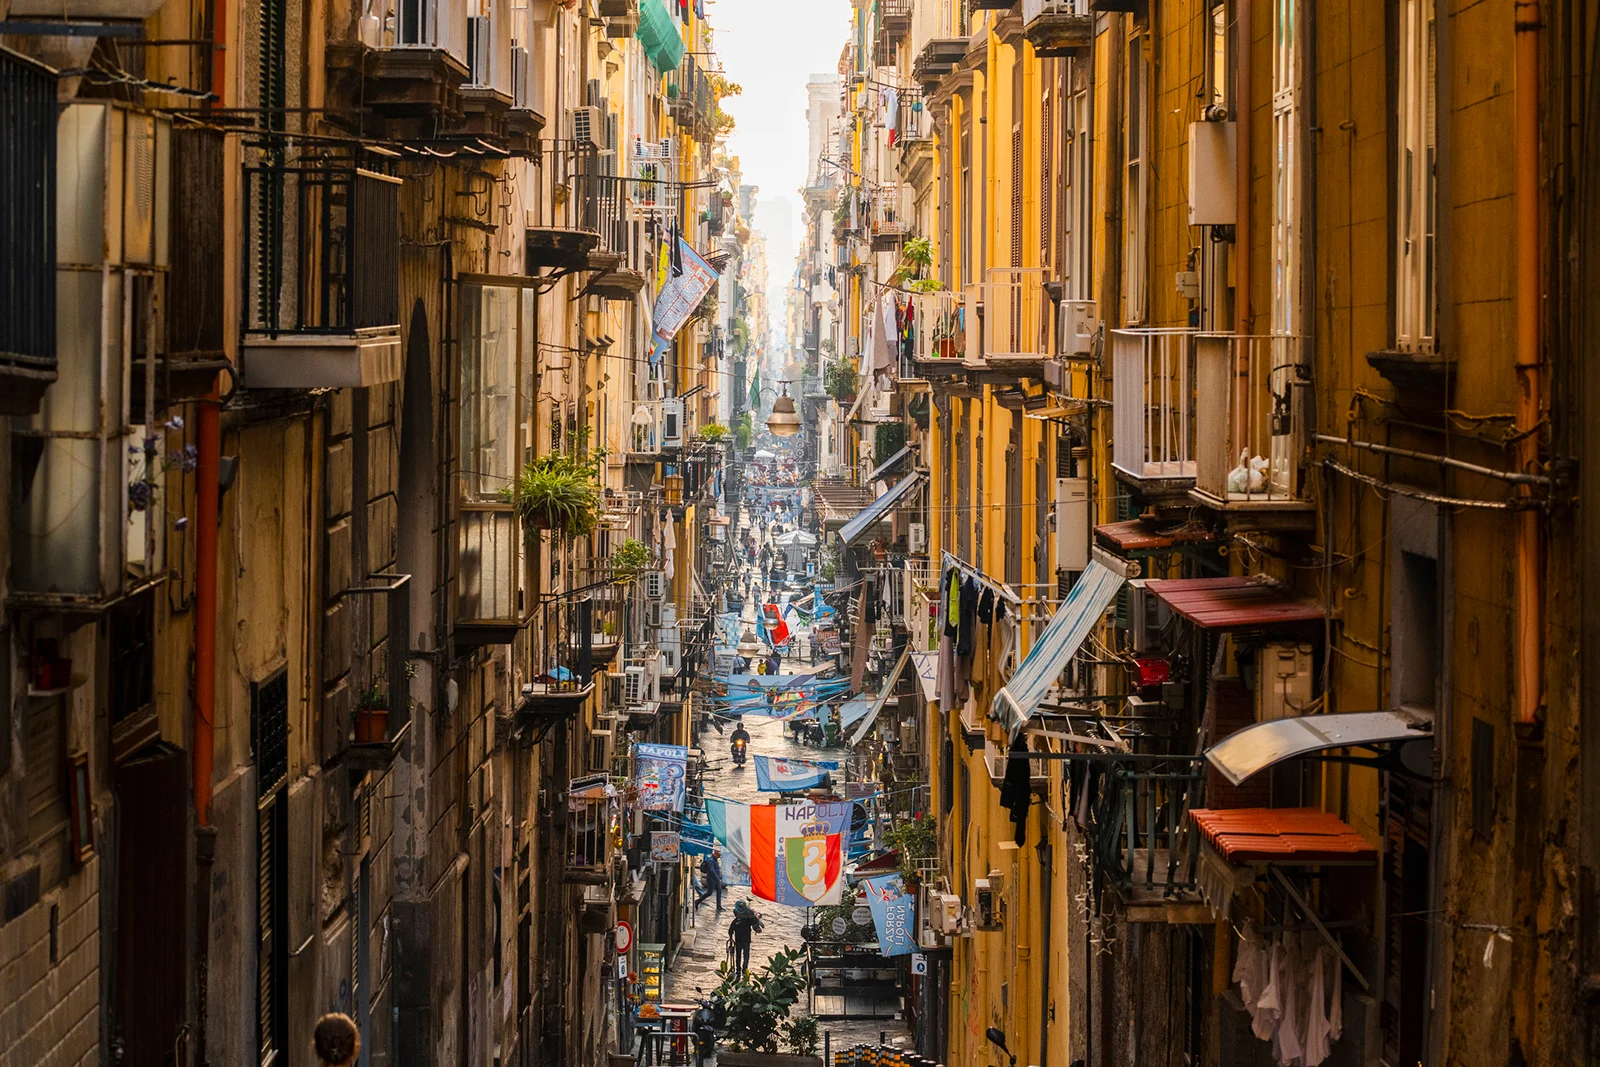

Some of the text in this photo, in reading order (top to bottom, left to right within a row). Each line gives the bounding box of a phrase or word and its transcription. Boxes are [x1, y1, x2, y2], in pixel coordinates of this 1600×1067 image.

[638, 744, 685, 758] NAPOLI
[785, 803, 846, 821] NAPOLI
[777, 837, 786, 903] CAMPIONE
[802, 842, 827, 885] 3
